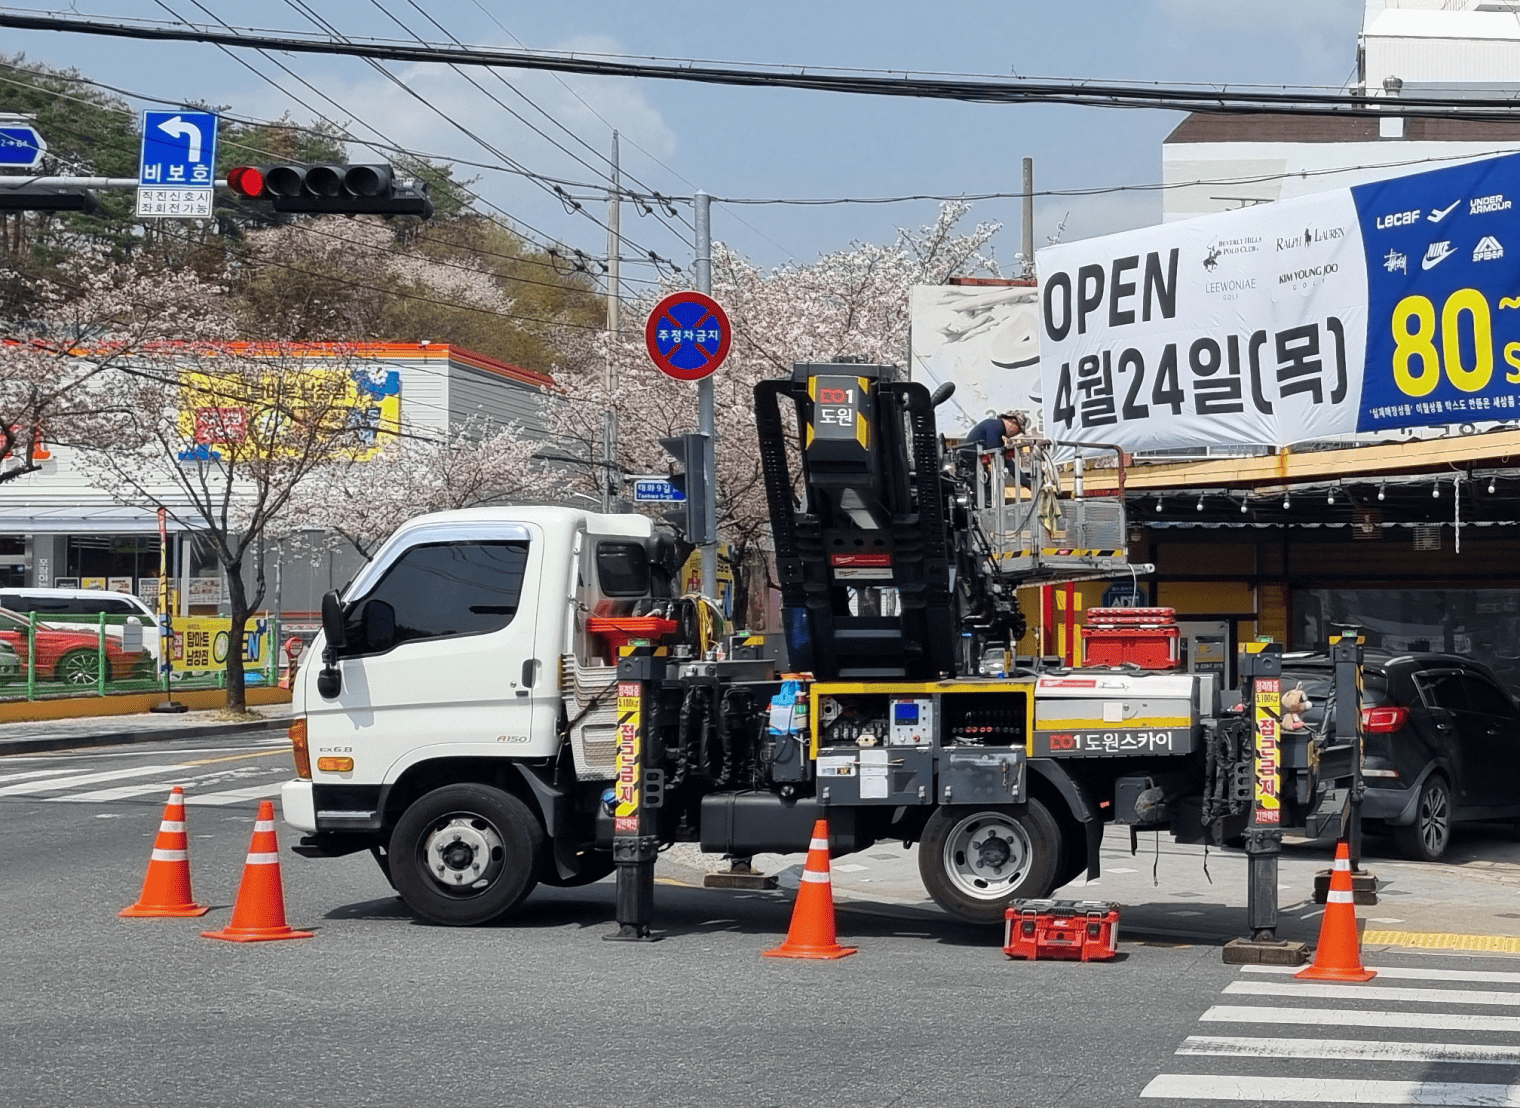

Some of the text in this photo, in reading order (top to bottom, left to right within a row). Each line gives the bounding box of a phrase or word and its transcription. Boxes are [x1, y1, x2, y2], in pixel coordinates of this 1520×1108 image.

[143, 163, 210, 184] 비보호
[141, 190, 209, 202] 직진신호시
[1469, 195, 1512, 215] UNDER ARMOUR
[141, 202, 208, 214] 좌회전가능
[1218, 236, 1262, 248] BEVERLY HILLS
[1276, 226, 1345, 252] RALPH LAUREN
[1223, 247, 1239, 255] POLO
[1426, 240, 1451, 258] NIKE
[1278, 262, 1339, 285] KIM YOUNG JOO
[1042, 247, 1180, 342] OPEN
[1205, 278, 1257, 294] LEEWONJAE
[1222, 293, 1239, 301] GOLF
[658, 329, 719, 343] 주정차금지
[1391, 288, 1494, 397] 80
[1052, 316, 1348, 430] 4월24일(목)
[1444, 399, 1467, 411] 박스도
[819, 408, 853, 426] 도원
[186, 631, 210, 648] 탑마트
[212, 630, 261, 664] OEN
[186, 649, 209, 667] 남창점
[1084, 731, 1173, 753] 도원스카이
[620, 724, 635, 804] 접근금지
[1260, 719, 1276, 796] 접근금지
